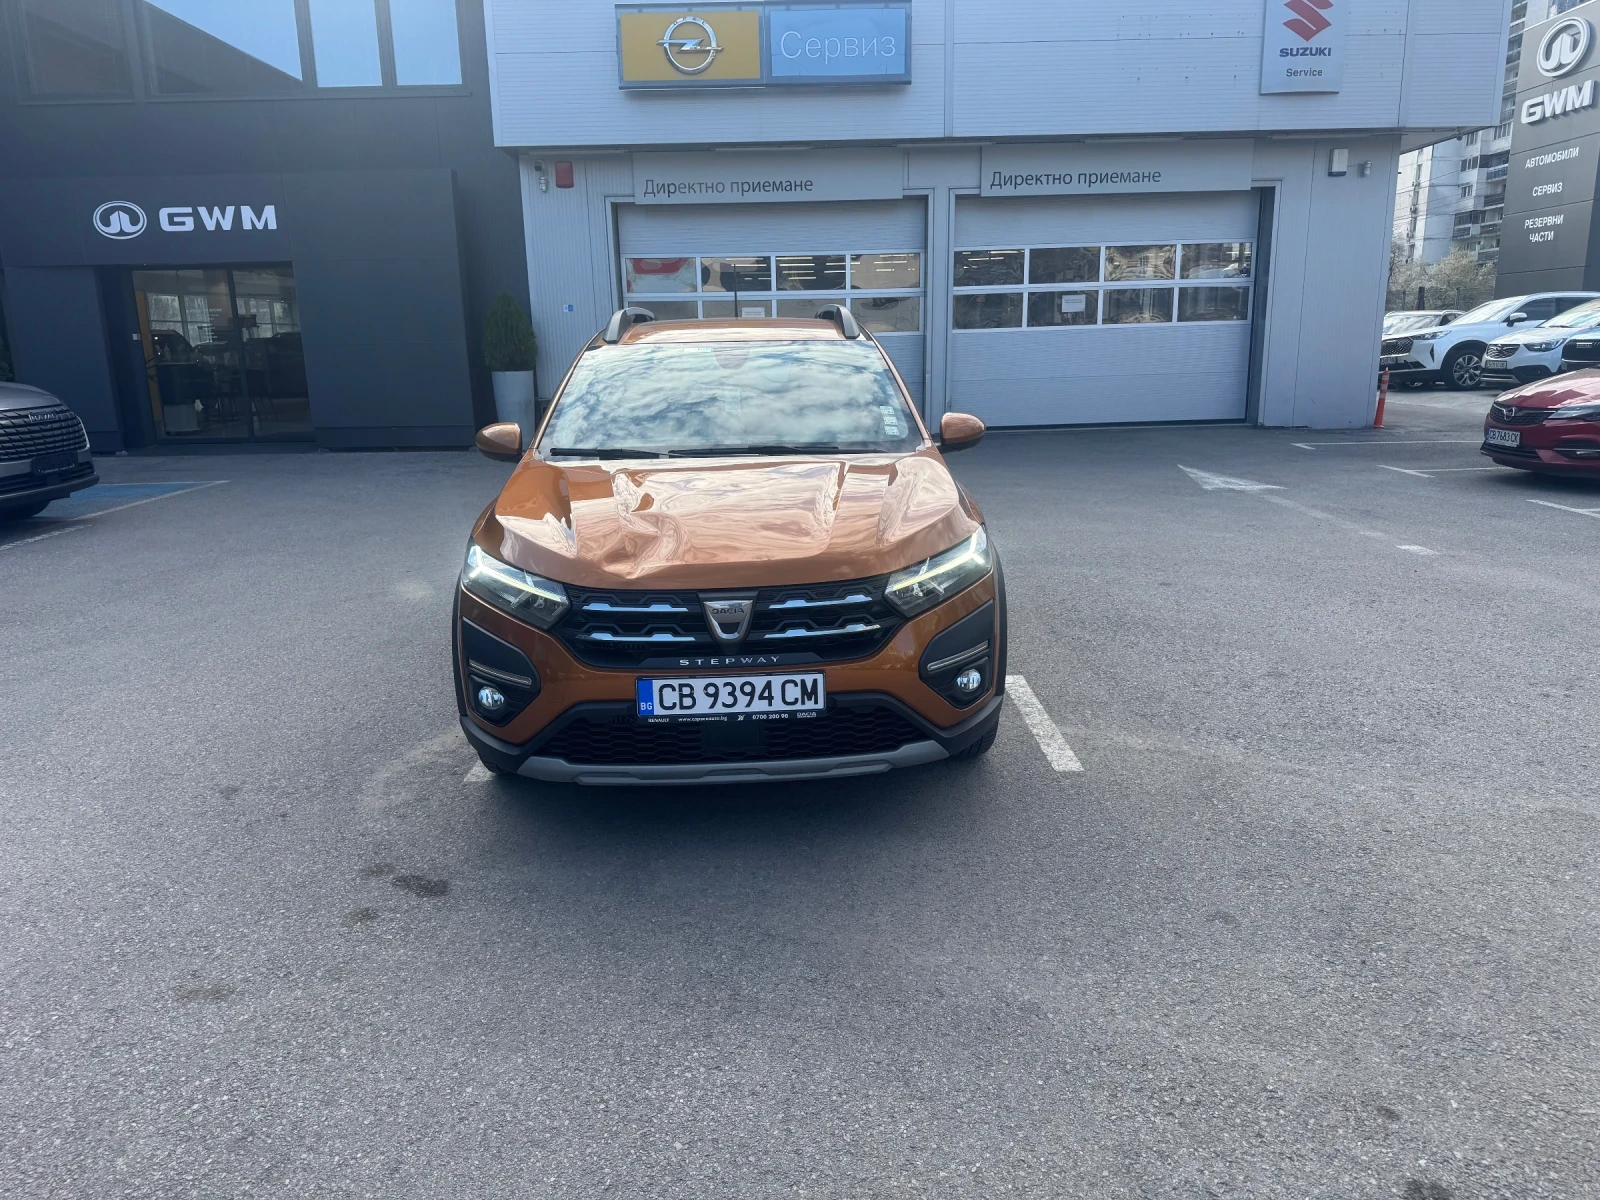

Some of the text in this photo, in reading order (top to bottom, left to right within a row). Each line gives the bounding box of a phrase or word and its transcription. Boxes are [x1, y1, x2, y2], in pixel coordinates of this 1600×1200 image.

[780, 30, 896, 65] Сервиз
[1279, 47, 1332, 57] SUZUKI
[1285, 67, 1323, 77] Service
[1520, 79, 1594, 125] GWM
[1525, 146, 1580, 169] АВТОМОБИЛИ
[643, 179, 814, 198] Директно приемане
[990, 171, 1162, 190] Директно приемане
[1532, 182, 1563, 197] СЕРВИЗ
[158, 204, 278, 232] GWM
[1524, 214, 1564, 229] РЕЗЕРВНИ
[1529, 231, 1554, 243] ЧАСТИ
[679, 655, 780, 666] STEPWAY
[658, 678, 819, 711] CB 9394 CM
[640, 702, 653, 711] BG
